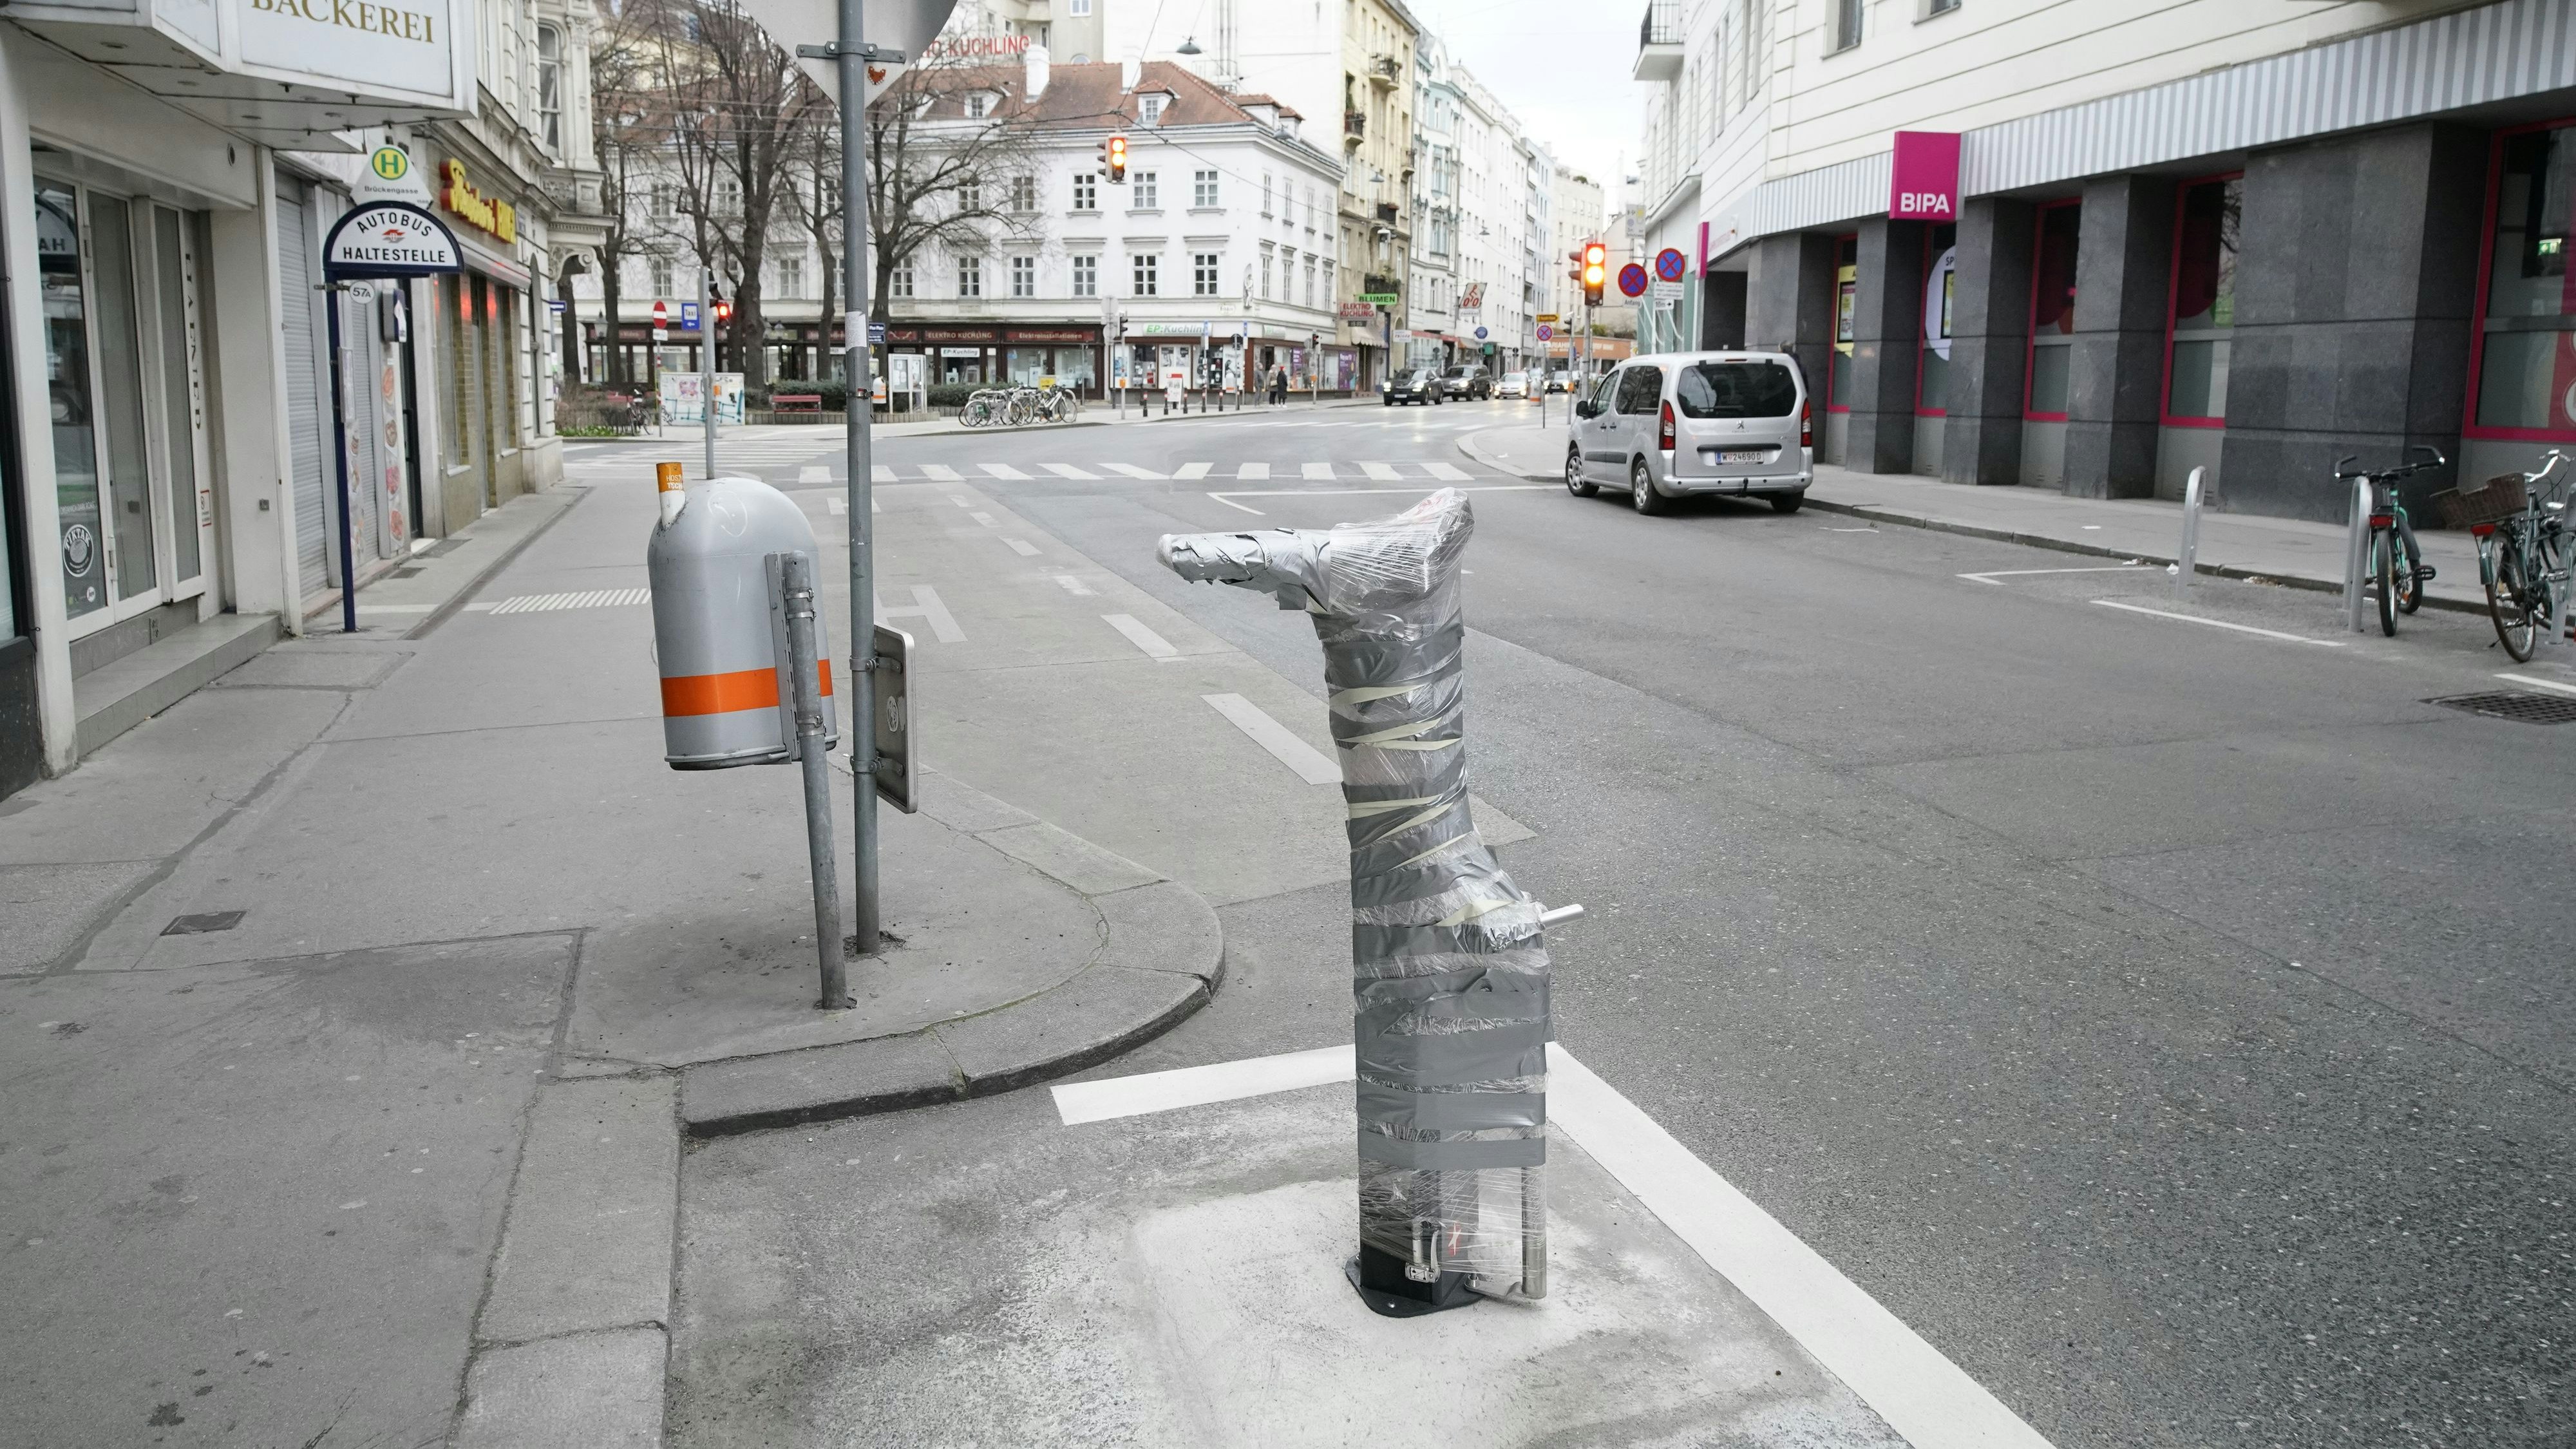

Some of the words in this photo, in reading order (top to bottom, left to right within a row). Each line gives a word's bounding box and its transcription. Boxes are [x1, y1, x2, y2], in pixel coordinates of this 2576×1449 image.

[365, 185, 419, 194] Brückengasse
[1900, 193, 1950, 213] BIPA
[357, 212, 432, 236] AUTOBUS
[343, 247, 446, 263] HALTESTELLE
[352, 287, 372, 298] 57A
